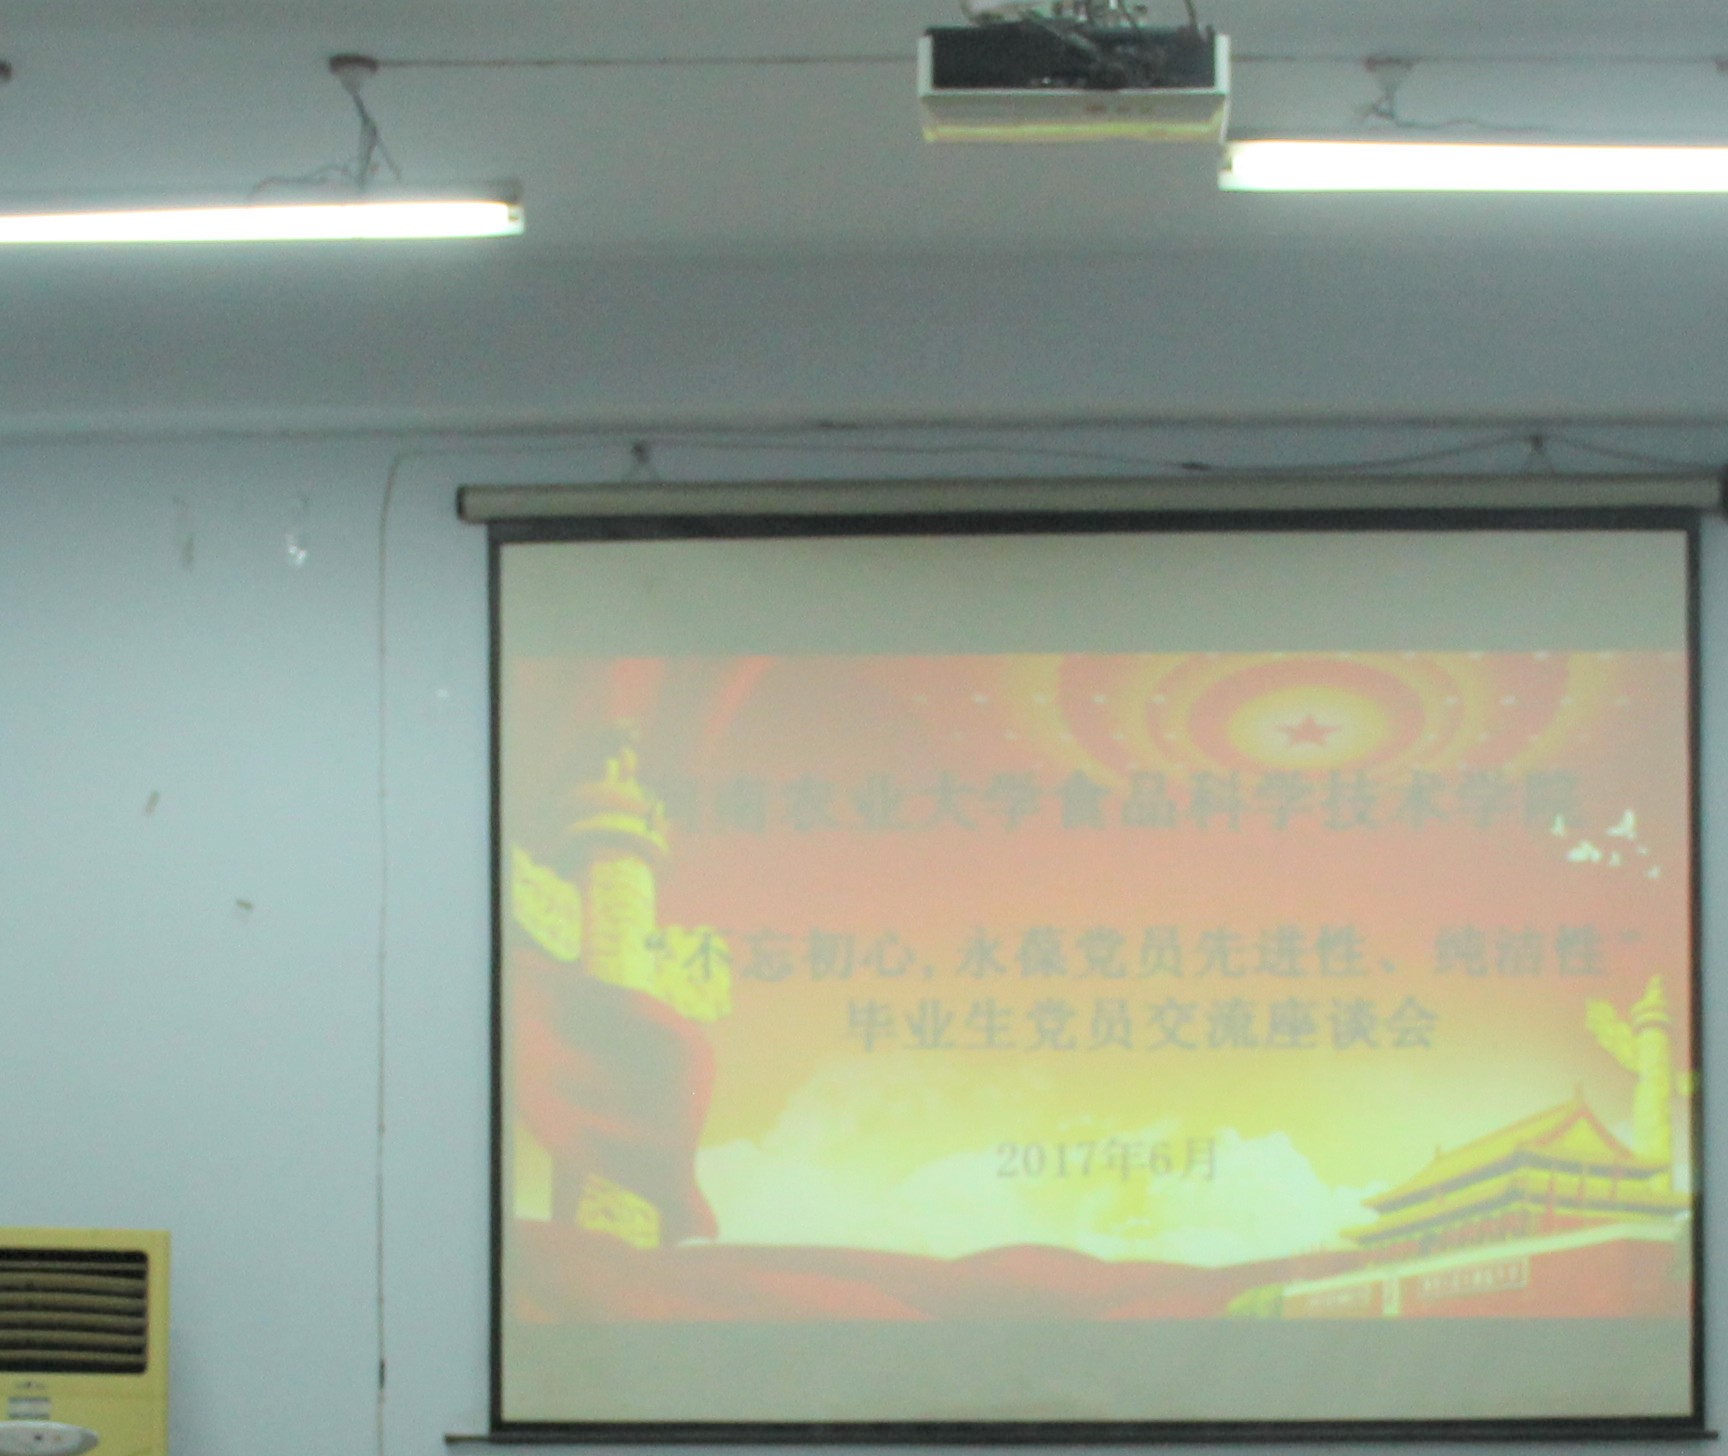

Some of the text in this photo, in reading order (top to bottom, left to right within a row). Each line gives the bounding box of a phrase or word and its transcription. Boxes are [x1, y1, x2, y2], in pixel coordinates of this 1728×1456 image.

[845, 996, 1439, 1053] 毕业生党员交流座谈会
[995, 1136, 1219, 1184] 2017年6月
